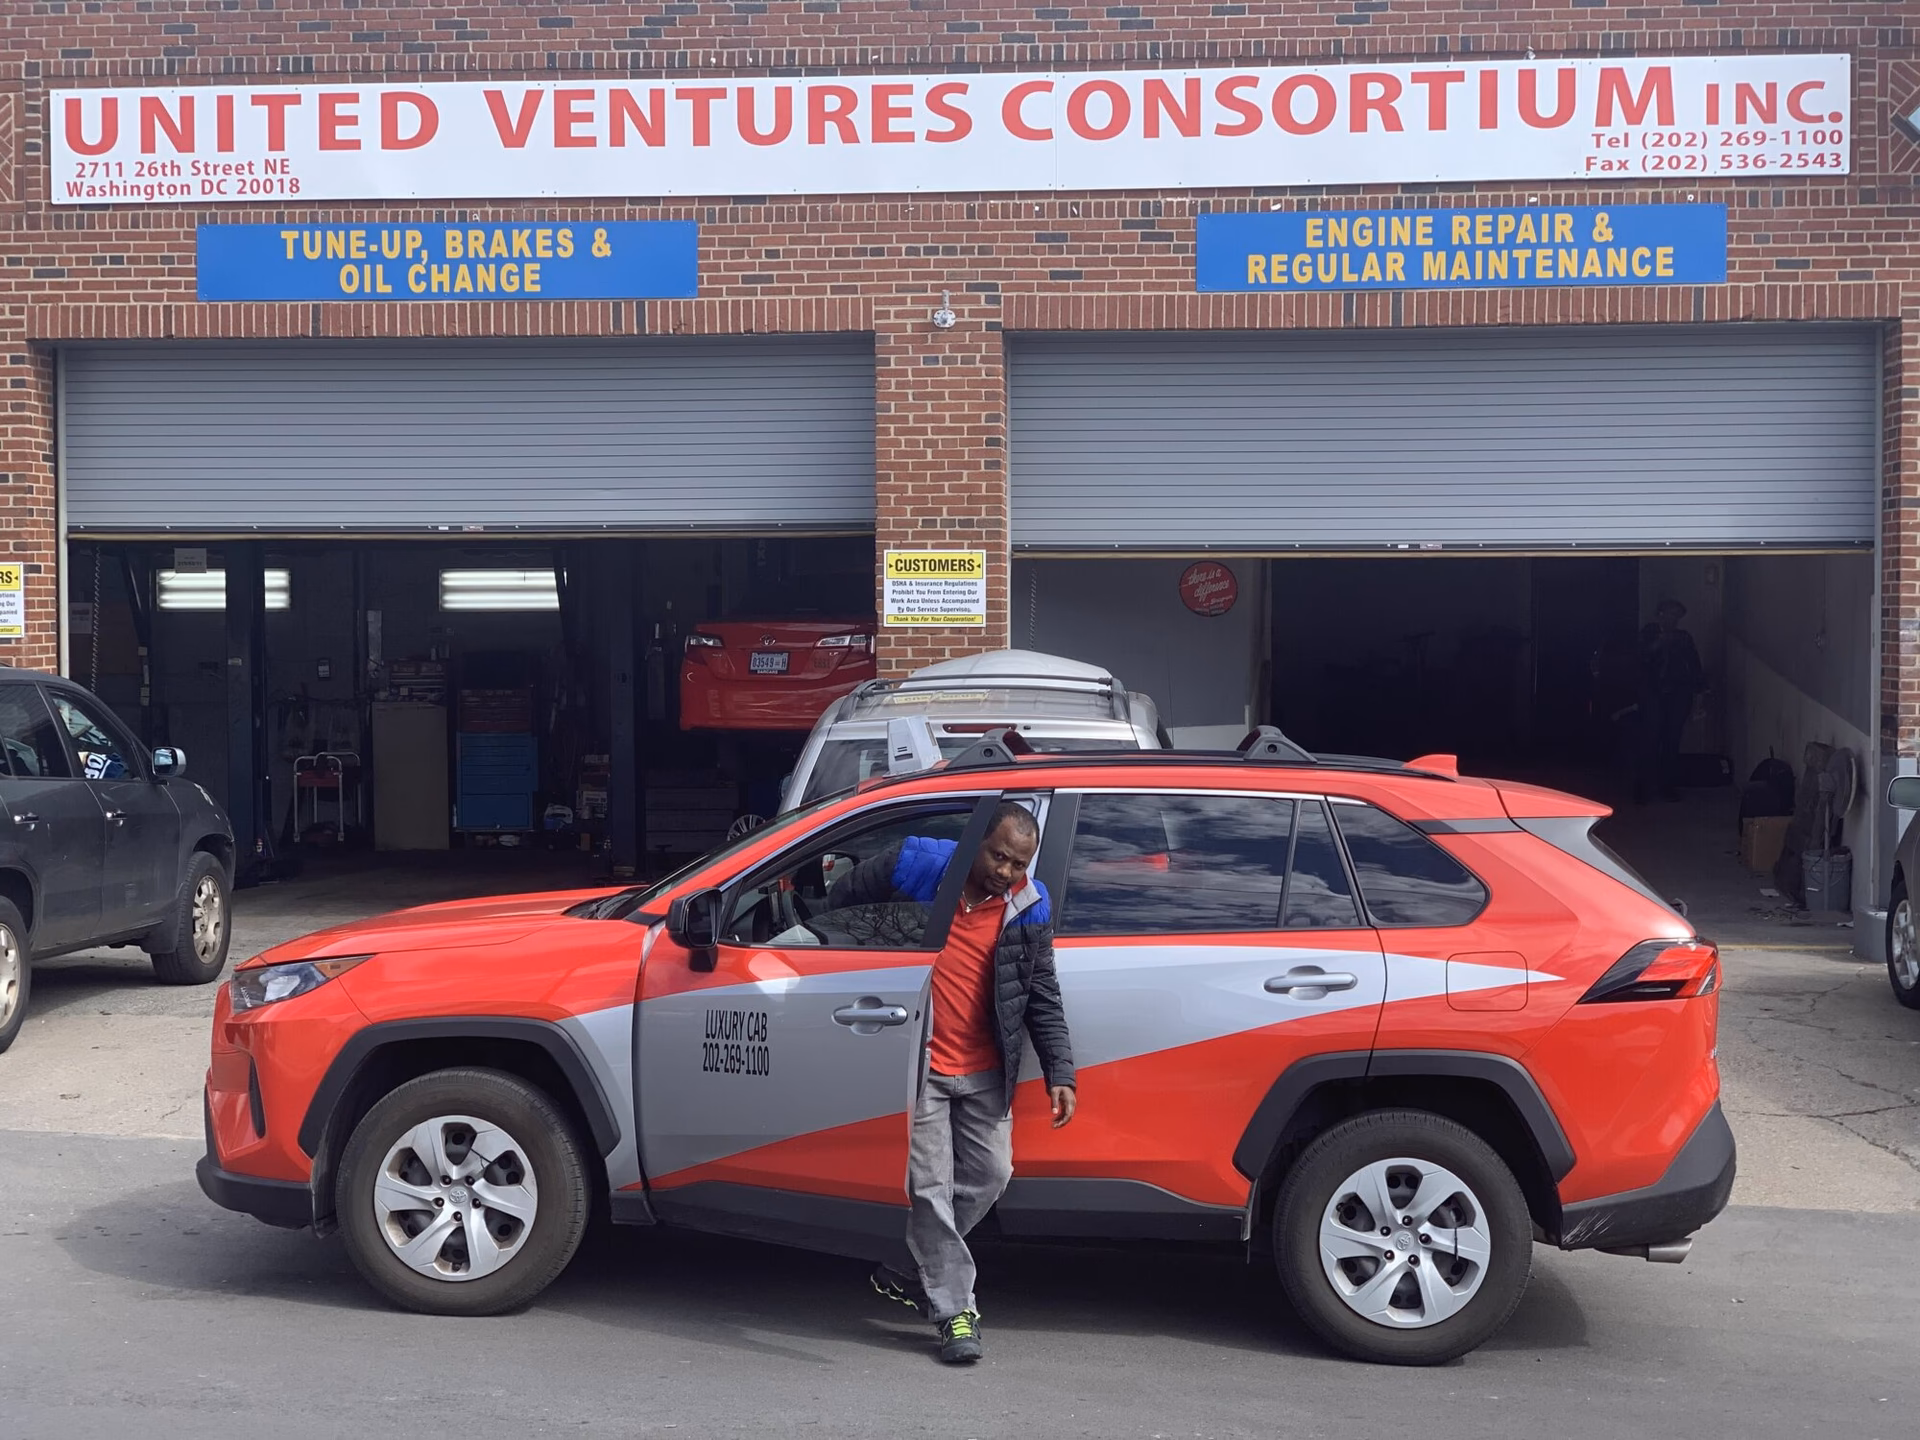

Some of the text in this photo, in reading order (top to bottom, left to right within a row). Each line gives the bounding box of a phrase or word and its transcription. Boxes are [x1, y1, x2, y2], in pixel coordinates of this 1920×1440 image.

[65, 66, 1843, 156] UNITED VENTURES CONSORTIUM INC.
[1592, 129, 1843, 150] Tel (202) 269-1100
[76, 158, 290, 179] 2711 26th Street NE
[1585, 152, 1842, 173] Fax (202) 536-2543
[66, 177, 300, 201] Washington DC 20018
[281, 228, 612, 263] TUNE-UP, BRAKES &
[1306, 212, 1614, 248] ENGINE REPAIR &
[340, 263, 541, 294] OIL CHANGE
[1247, 246, 1674, 284] REGULAR MAINTENANCE
[895, 558, 975, 572] CUSTOMERS
[944, 580, 978, 588] Regulations
[705, 1009, 768, 1043] LUXURY CAB
[702, 1042, 771, 1077] 202-269-1100
